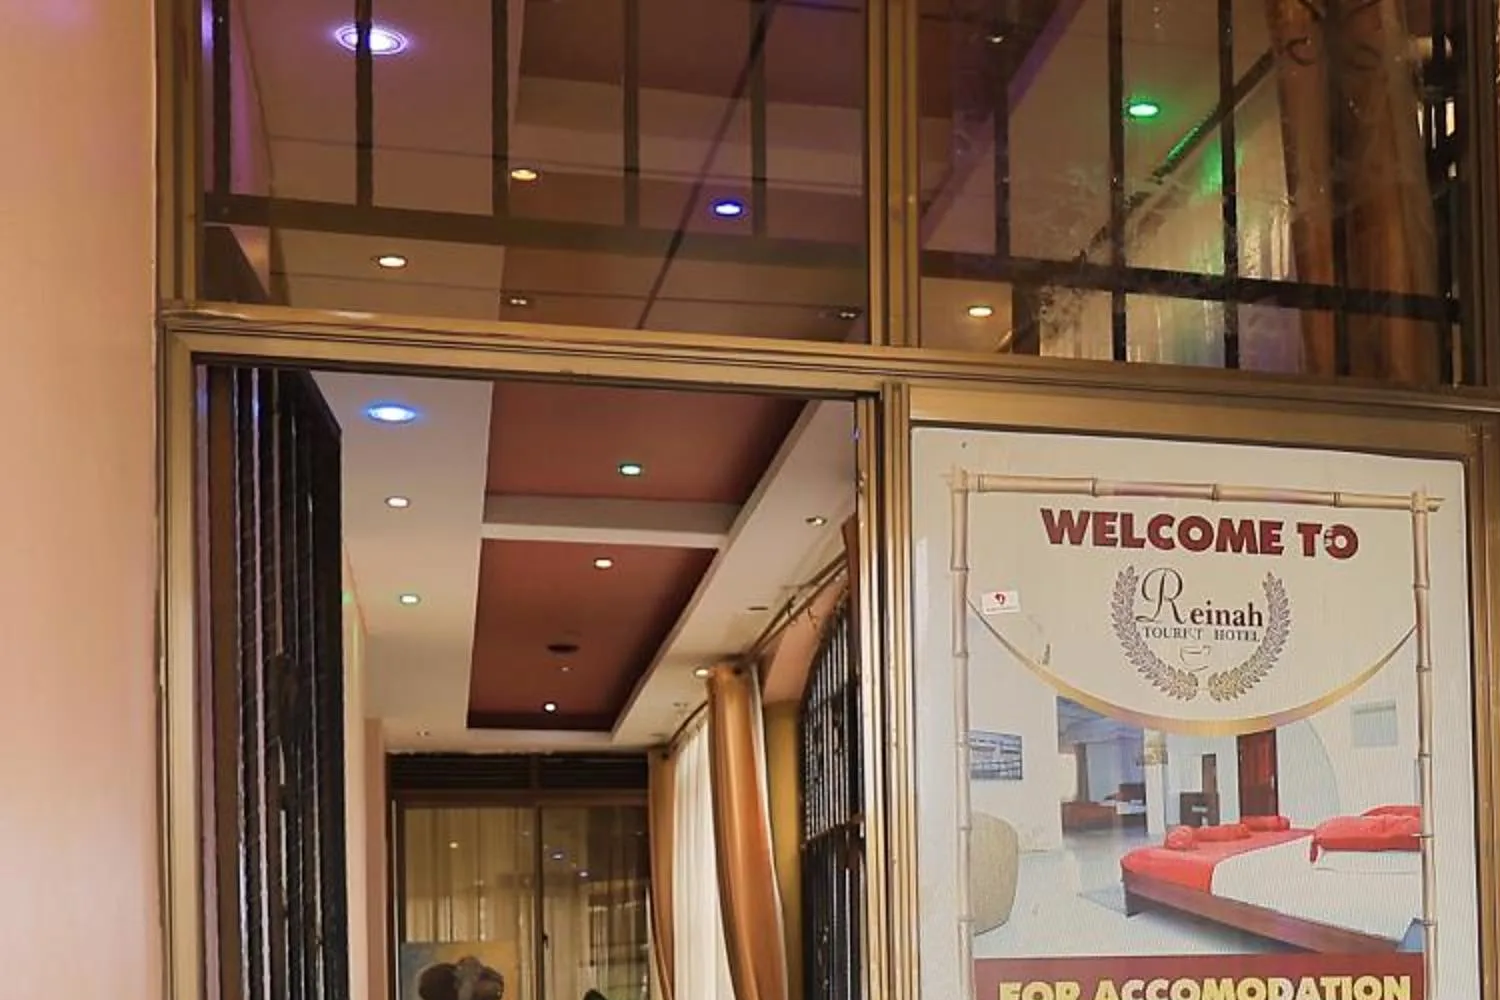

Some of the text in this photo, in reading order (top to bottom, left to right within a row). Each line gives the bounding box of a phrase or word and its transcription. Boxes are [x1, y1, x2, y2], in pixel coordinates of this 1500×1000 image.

[1040, 508, 1359, 559] WELCOME TO
[1135, 567, 1263, 627] Reinah
[1214, 628, 1261, 642] HOTEL
